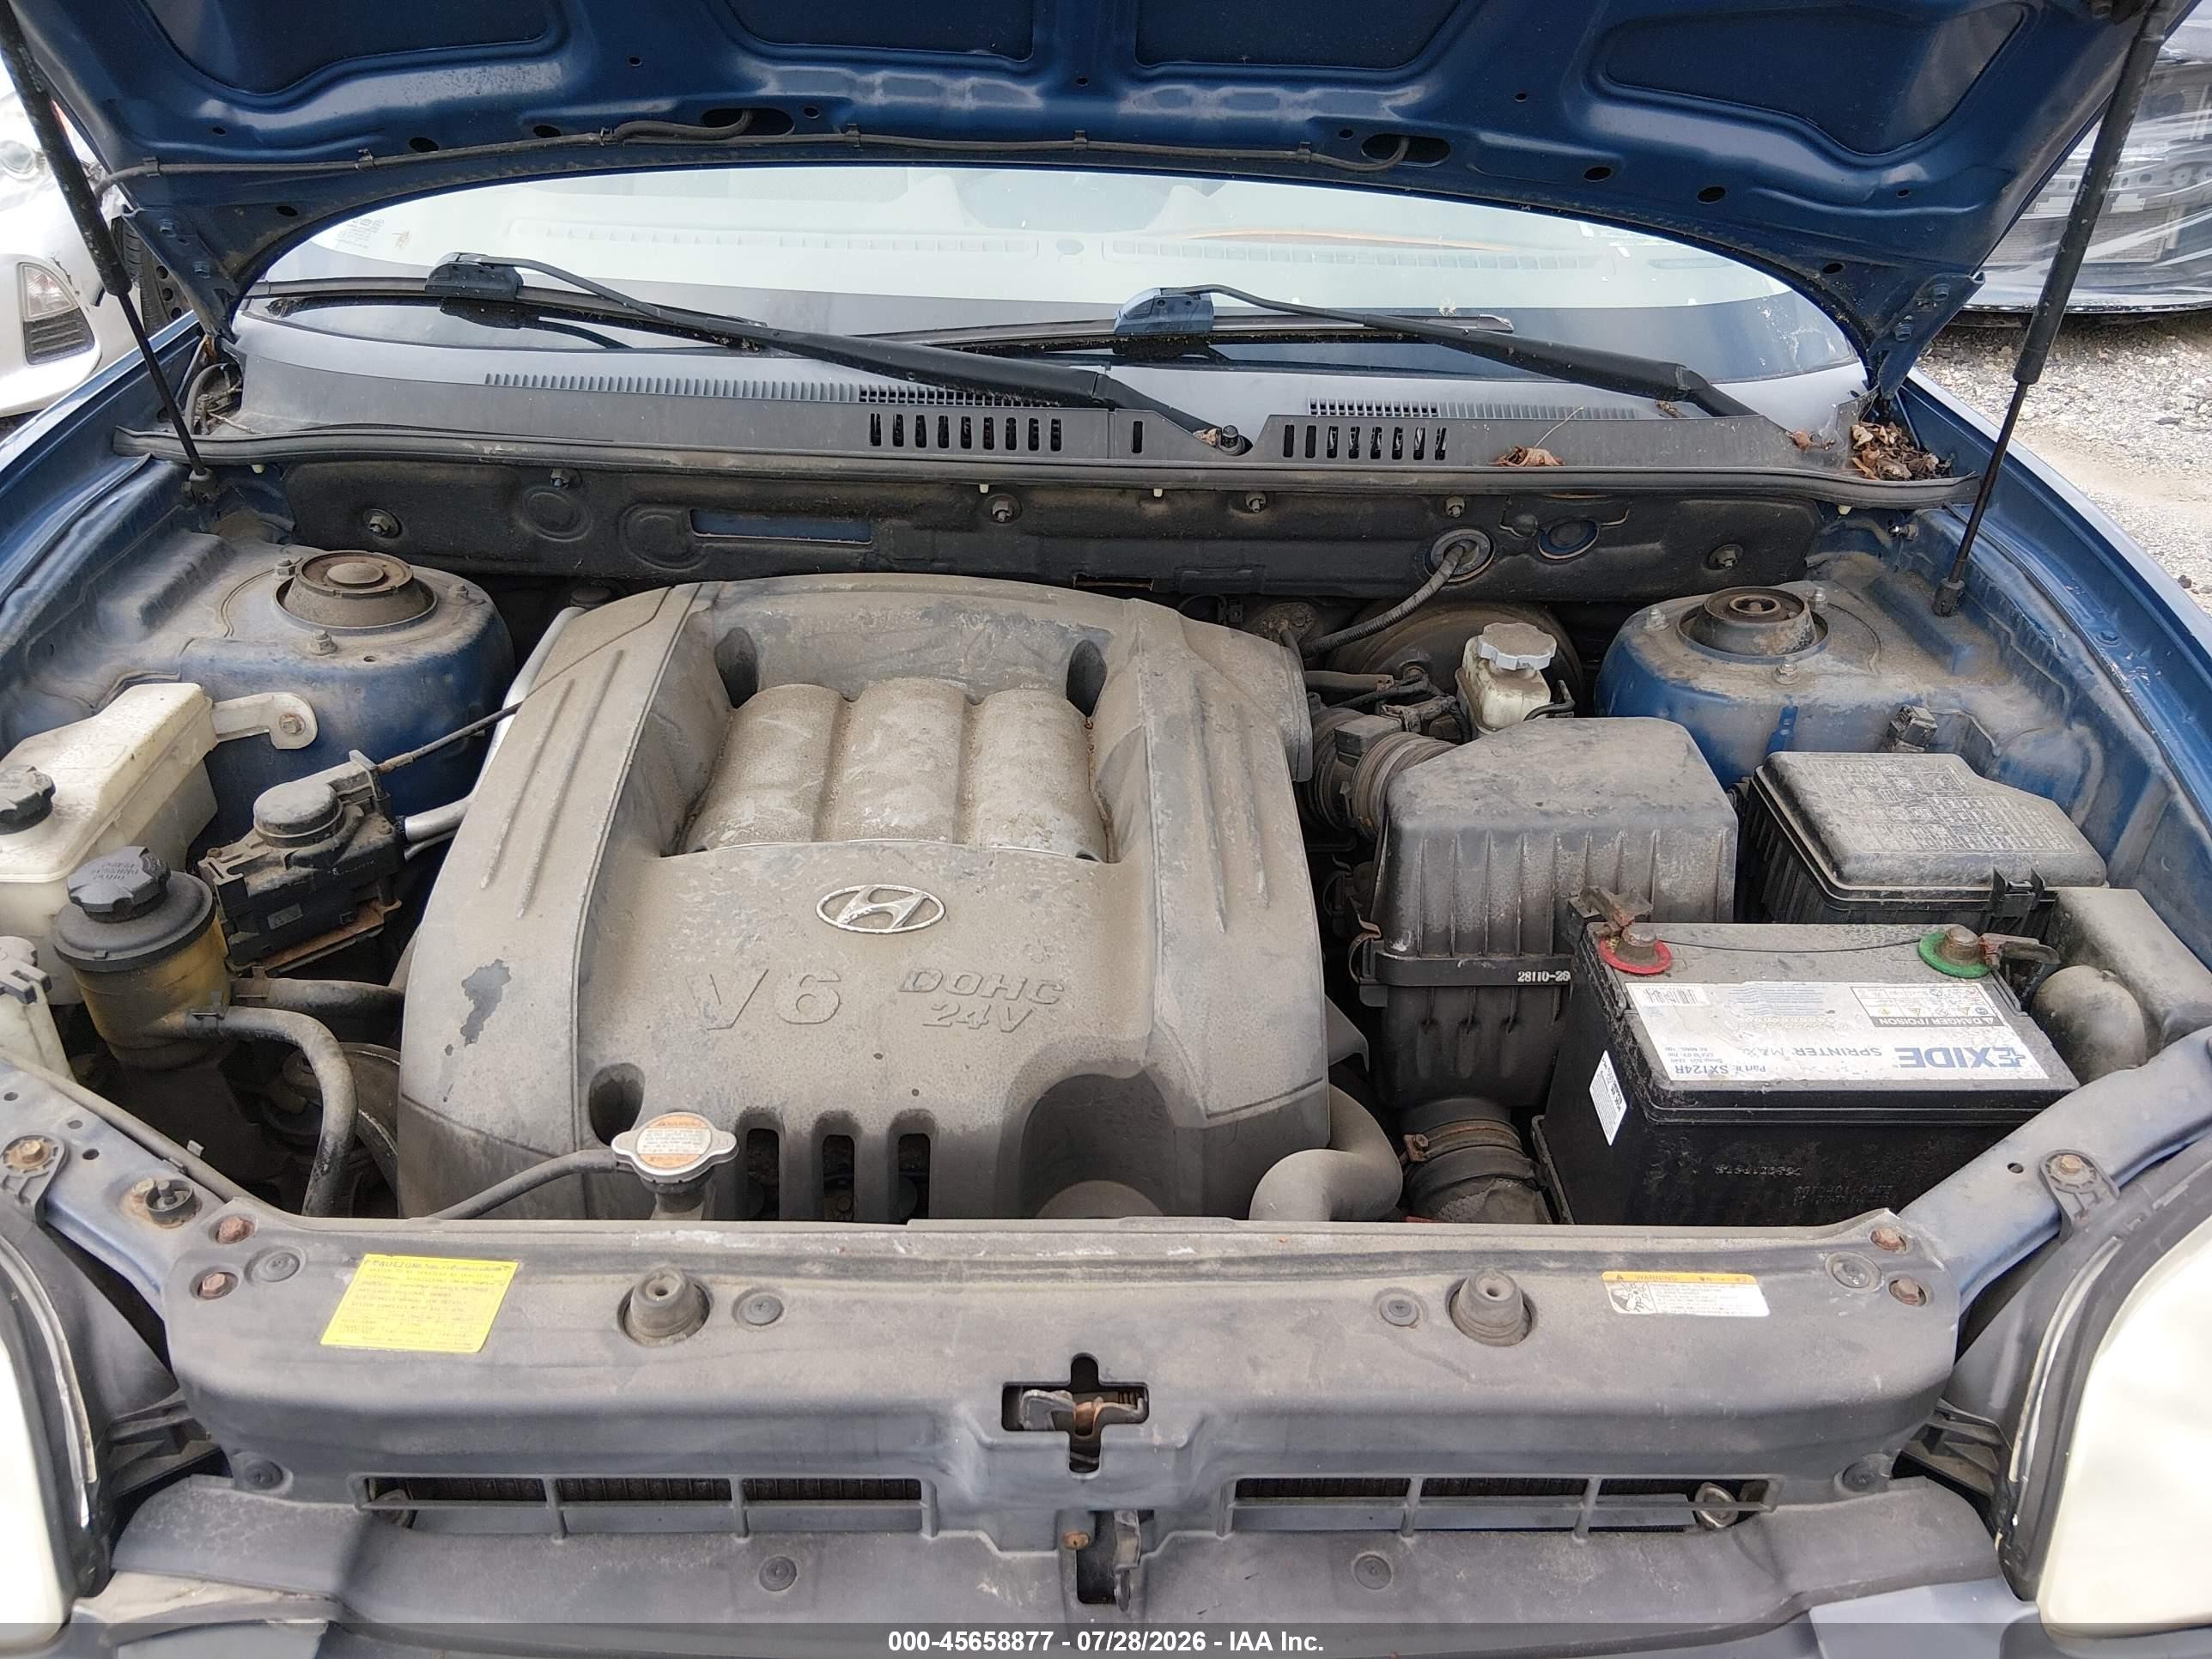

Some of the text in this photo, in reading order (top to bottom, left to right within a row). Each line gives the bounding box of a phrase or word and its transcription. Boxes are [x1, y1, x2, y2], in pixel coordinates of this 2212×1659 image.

[899, 968, 1065, 1005] DOHC
[687, 968, 841, 1030] V6
[922, 1002, 1032, 1033] 24V
[1931, 1017, 1984, 1025] DANGER
[1793, 1047, 1883, 1057] SPRINTER
[1894, 1047, 2027, 1068] EXIDE
[1674, 1064, 1729, 1074] SX124R
